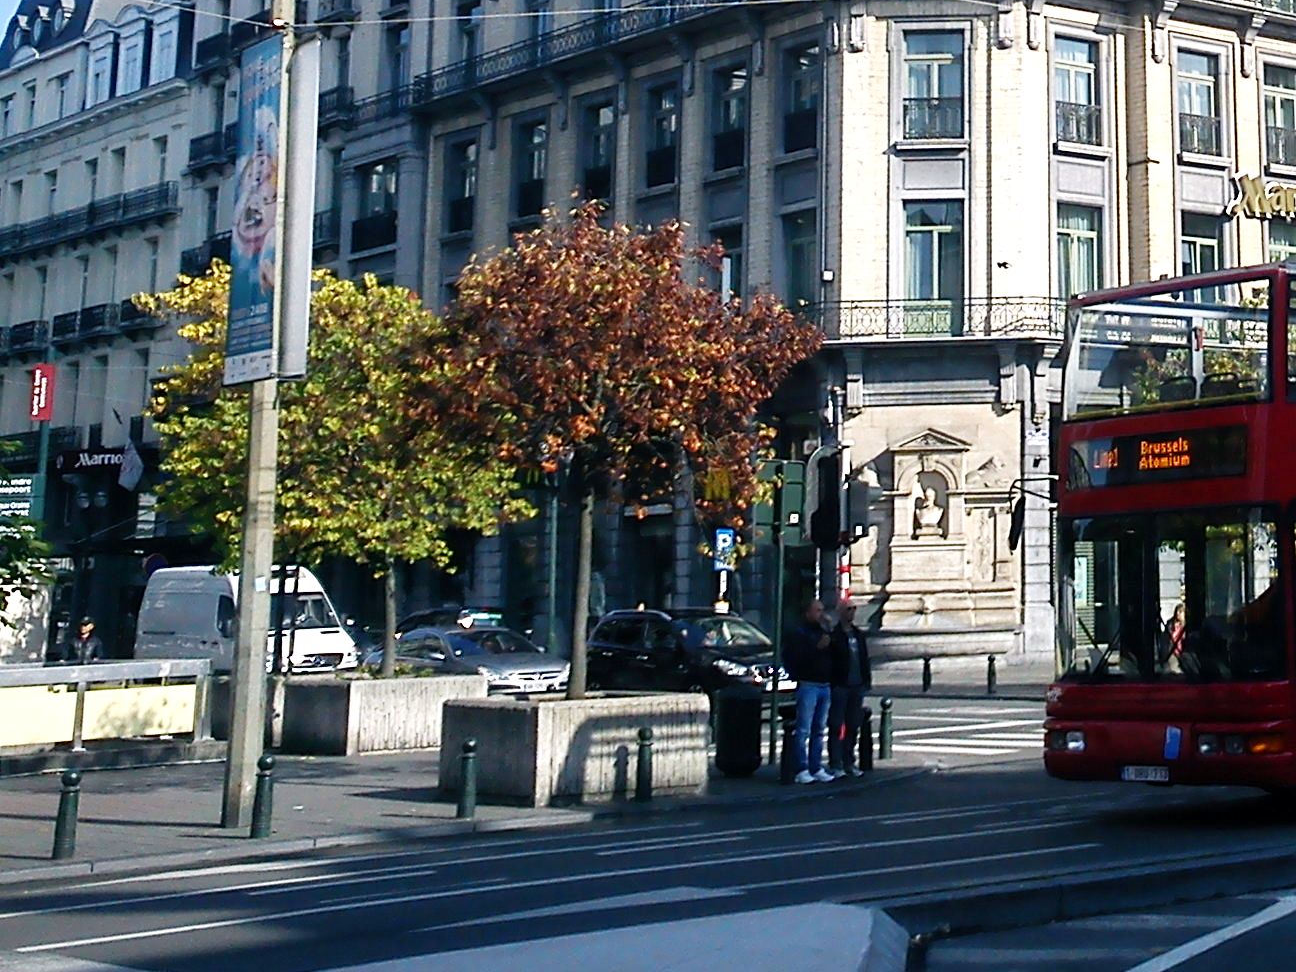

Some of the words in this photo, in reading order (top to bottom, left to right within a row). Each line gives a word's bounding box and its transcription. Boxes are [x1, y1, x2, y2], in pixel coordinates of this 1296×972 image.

[1140, 437, 1189, 455] Brussels
[74, 453, 123, 468] Marrio
[1139, 453, 1190, 469] Atomium
